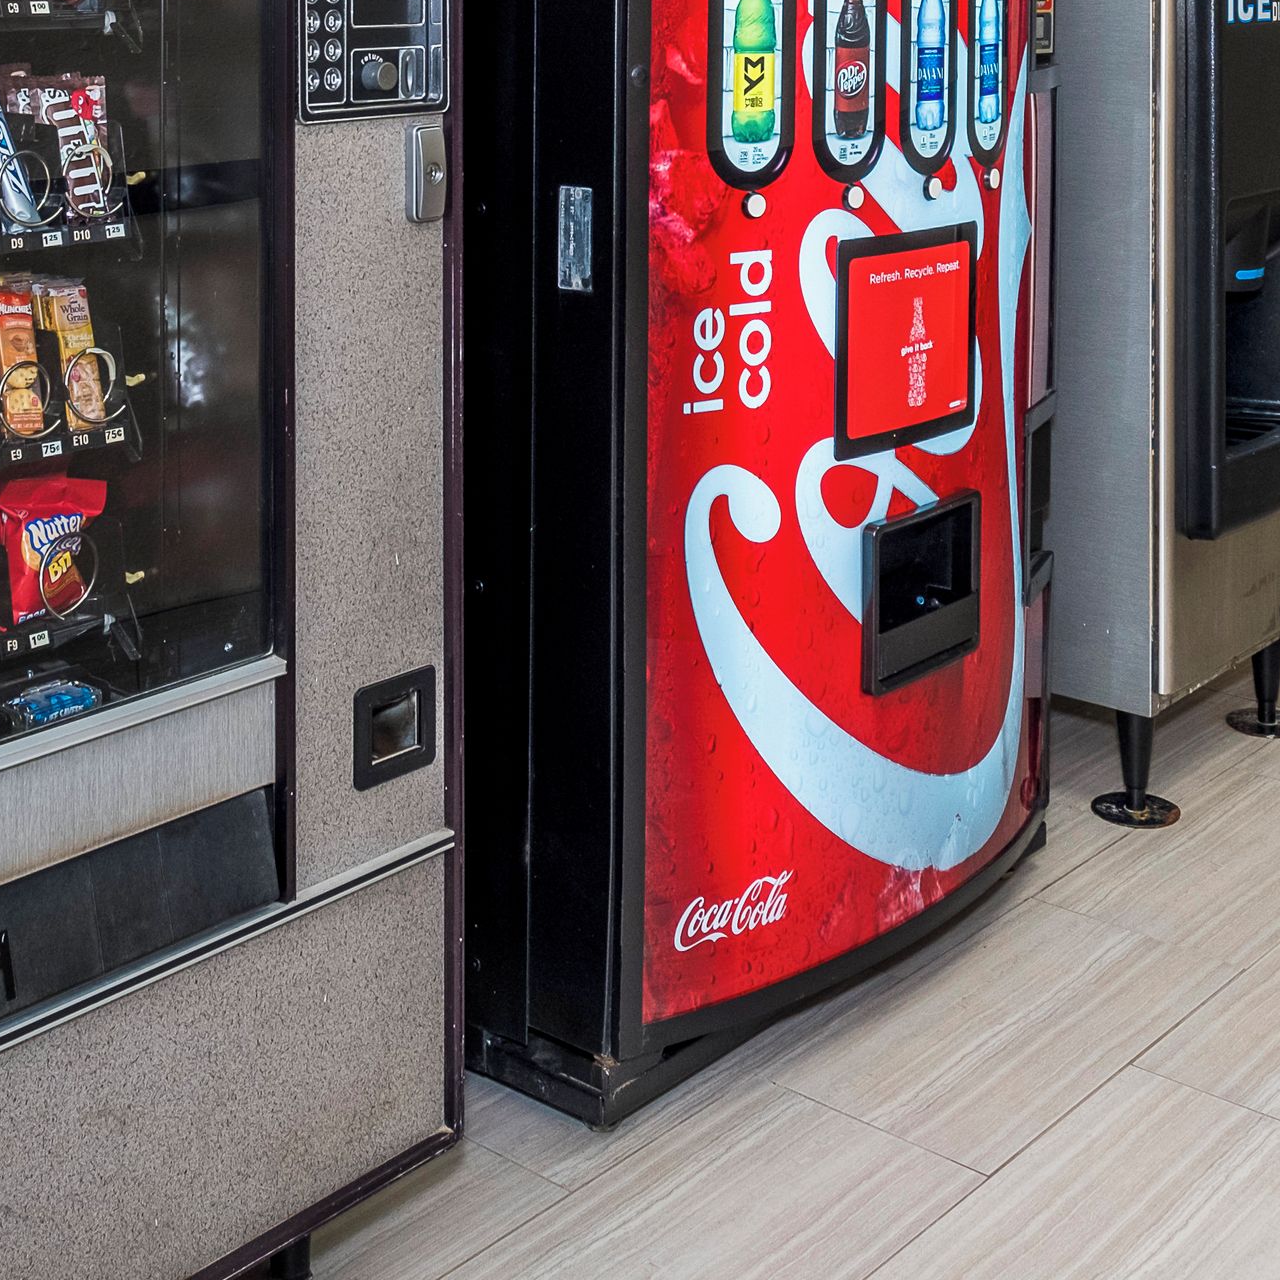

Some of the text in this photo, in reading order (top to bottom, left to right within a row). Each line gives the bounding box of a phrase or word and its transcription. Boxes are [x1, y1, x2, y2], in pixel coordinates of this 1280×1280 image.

[7, 2, 19, 14] C9
[360, 52, 384, 65] return
[326, 73, 337, 85] 10
[847, 65, 860, 80] Dr
[838, 70, 867, 94] Pepper
[73, 228, 91, 241] D10
[10, 237, 24, 250] D9
[869, 260, 961, 285] Refresh. Recycle. Repeat.
[59, 304, 87, 315] Whole
[66, 313, 89, 322] Grain
[728, 249, 773, 410] cold
[900, 345, 914, 357] give
[682, 306, 727, 415] ice
[72, 429, 123, 447] E10 75¢
[10, 448, 23, 461] E9
[28, 514, 82, 549] Nutter
[6, 639, 19, 652] F9
[673, 868, 794, 952] Coca-Cola
